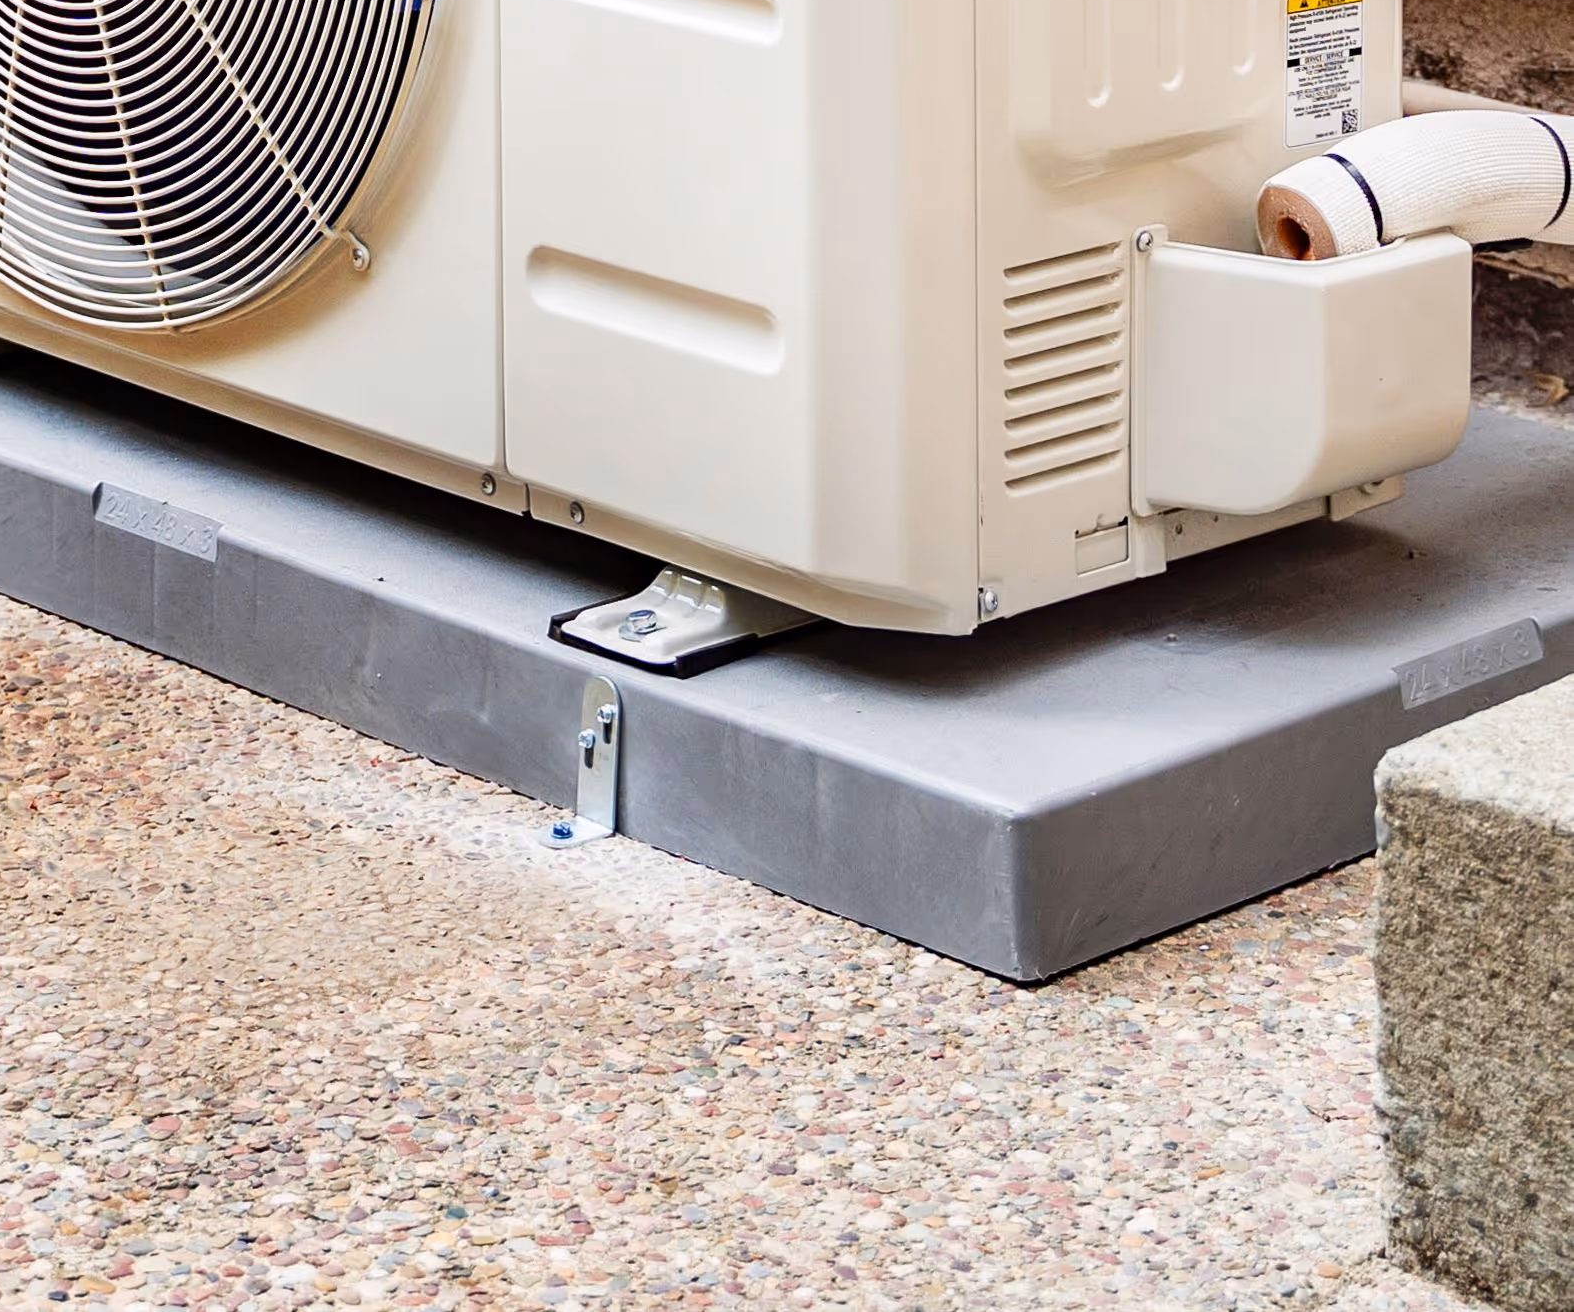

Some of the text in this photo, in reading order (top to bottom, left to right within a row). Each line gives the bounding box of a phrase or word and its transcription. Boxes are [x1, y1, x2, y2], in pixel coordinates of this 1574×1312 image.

[104, 490, 131, 525] 24
[151, 511, 178, 541] 48
[200, 526, 213, 554] 3
[1405, 663, 1431, 702] 24
[1460, 645, 1490, 676] 48
[1496, 642, 1512, 668] x
[1513, 628, 1530, 658] 3
